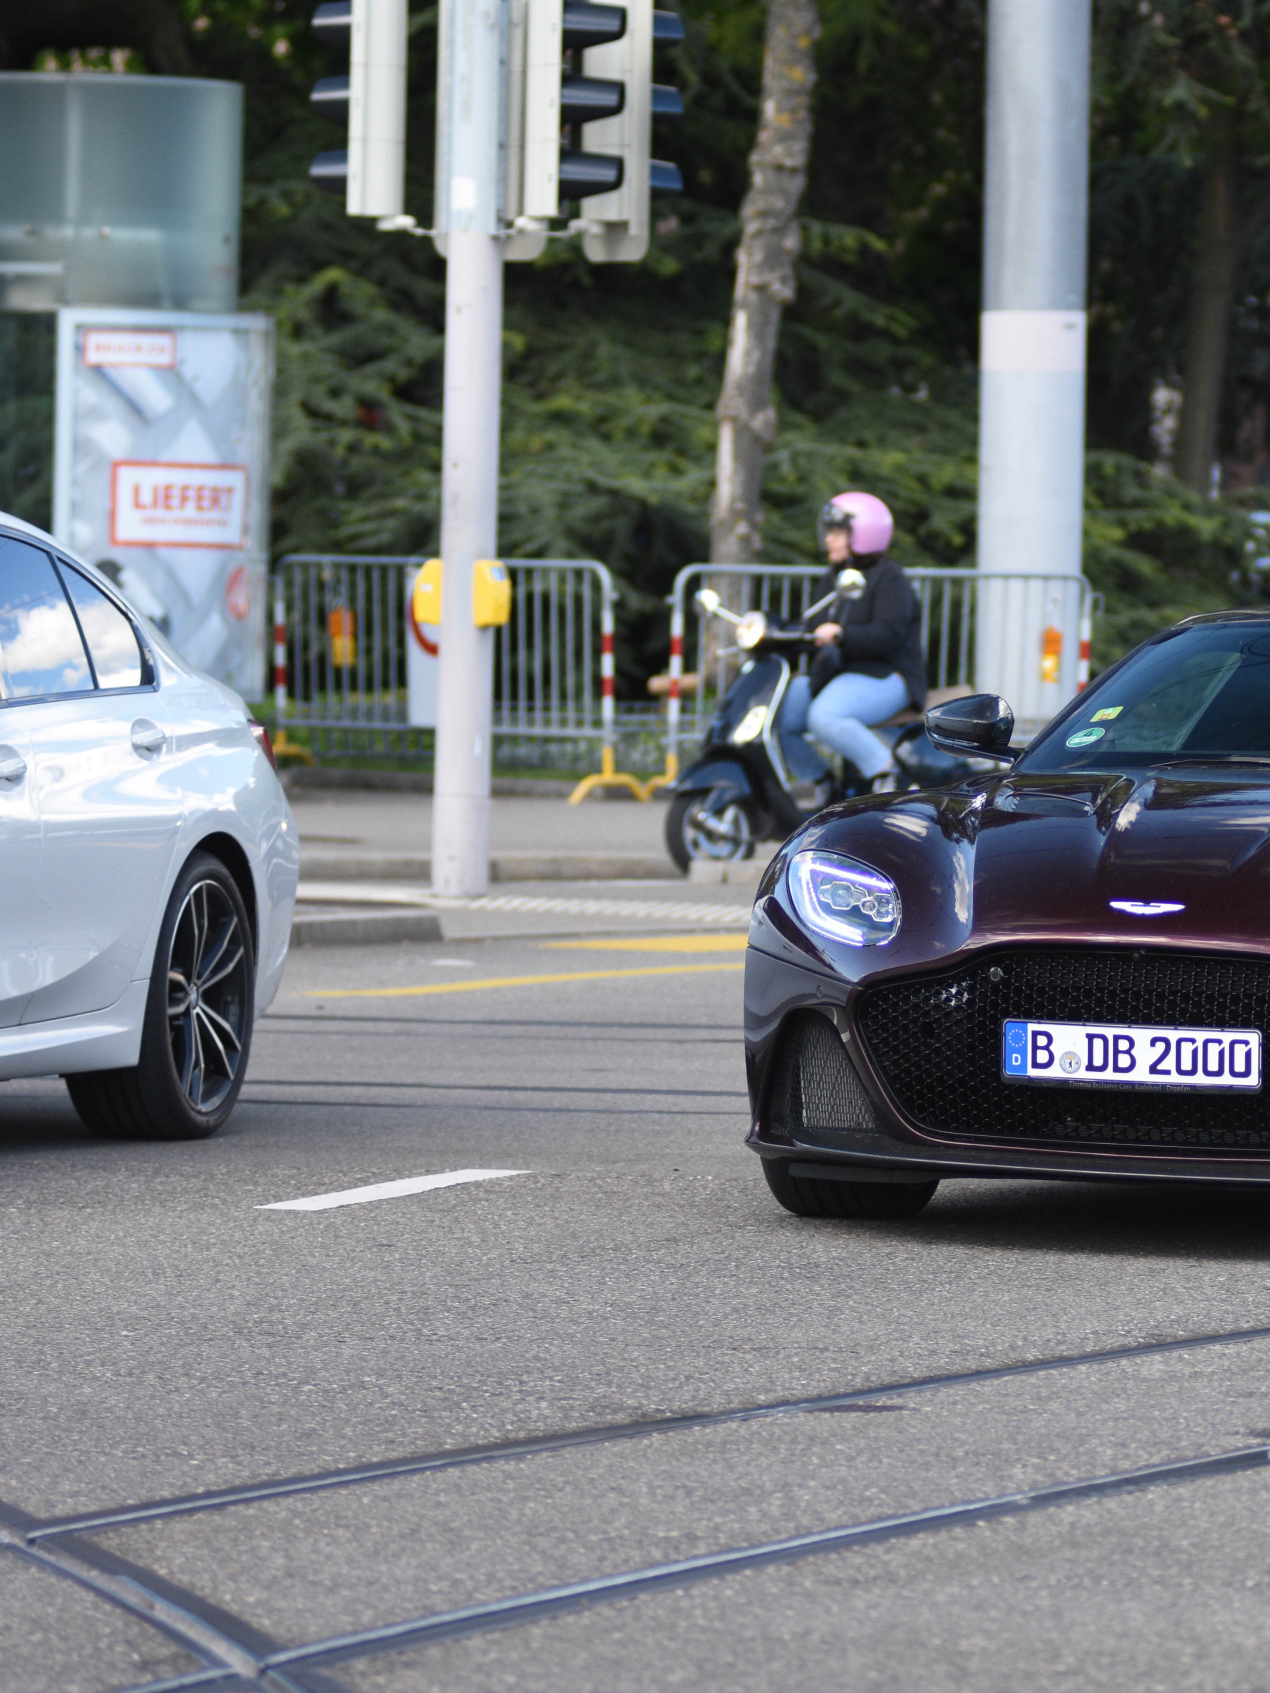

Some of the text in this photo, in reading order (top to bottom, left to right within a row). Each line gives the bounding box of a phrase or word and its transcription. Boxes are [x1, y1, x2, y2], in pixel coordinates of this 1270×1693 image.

[133, 483, 235, 512] LIEFERT
[1012, 1053, 1021, 1065] D
[1031, 1030, 1252, 1078] B DB 2000
[1069, 1080, 1091, 1088] Thomas
